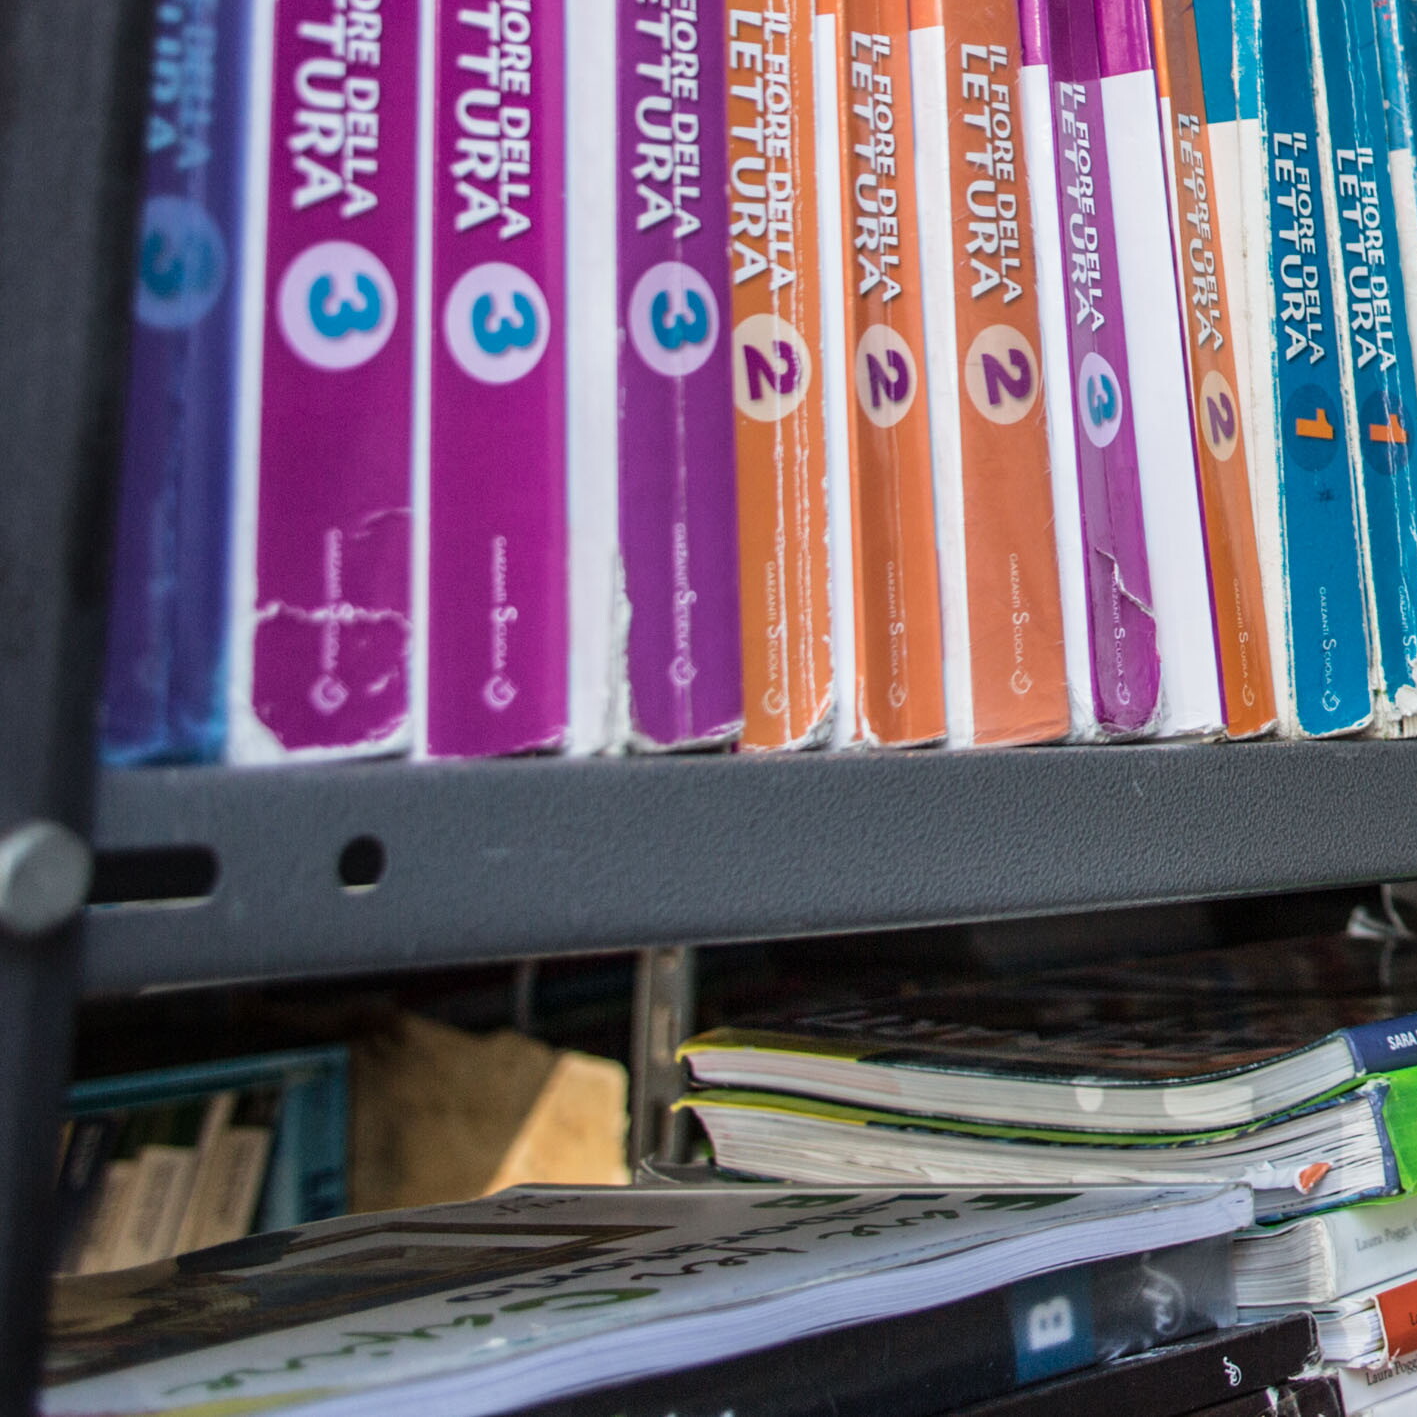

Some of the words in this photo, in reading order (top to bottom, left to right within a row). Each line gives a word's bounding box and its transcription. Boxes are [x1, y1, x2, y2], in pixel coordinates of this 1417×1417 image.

[763, 11, 791, 43] IL
[872, 34, 891, 63] IL
[989, 45, 1008, 72] IL
[764, 53, 792, 157] FIORE
[873, 75, 896, 176] FIORE
[990, 84, 1015, 182] FIORE
[1071, 83, 1087, 106] IL
[1189, 115, 1201, 139] IL
[341, 77, 380, 219] DELLA
[498, 105, 532, 241] DELLA
[671, 112, 702, 241] DELLA
[728, 9, 768, 287] LETTURA
[850, 30, 881, 297] LETTURA
[960, 43, 1000, 299] LETTURA
[1074, 121, 1097, 216] FIORE
[1292, 132, 1308, 157] IL
[1356, 147, 1374, 172] IL
[766, 172, 797, 292] DELLA
[1059, 83, 1091, 326] LETTURA
[1177, 113, 1213, 348] LETTURA
[1194, 151, 1212, 240] FIORE
[1296, 168, 1317, 255] FIORE
[1361, 183, 1386, 265] FIORE
[878, 188, 902, 304] DELLA
[996, 193, 1023, 304] DELLA
[1084, 226, 1106, 333] DELLA
[1273, 132, 1308, 361] LETTURA
[1336, 148, 1377, 370] LETTURA
[308, 272, 383, 340] 3
[471, 291, 535, 356] 3
[650, 289, 709, 350] 3
[1203, 251, 1224, 351] DELLA
[1302, 265, 1326, 365] DELLA
[1370, 275, 1397, 372] DELLA
[742, 340, 803, 402] 2
[865, 349, 909, 408] 2
[980, 348, 1032, 406] 2
[1086, 373, 1117, 427] 3
[1206, 391, 1235, 444] 2
[1294, 407, 1334, 440] 1
[1368, 414, 1407, 444] 1
[1386, 1030, 1417, 1051] SARA
[446, 1192, 952, 1304] Laboratorio
[1027, 1295, 1075, 1352] B
